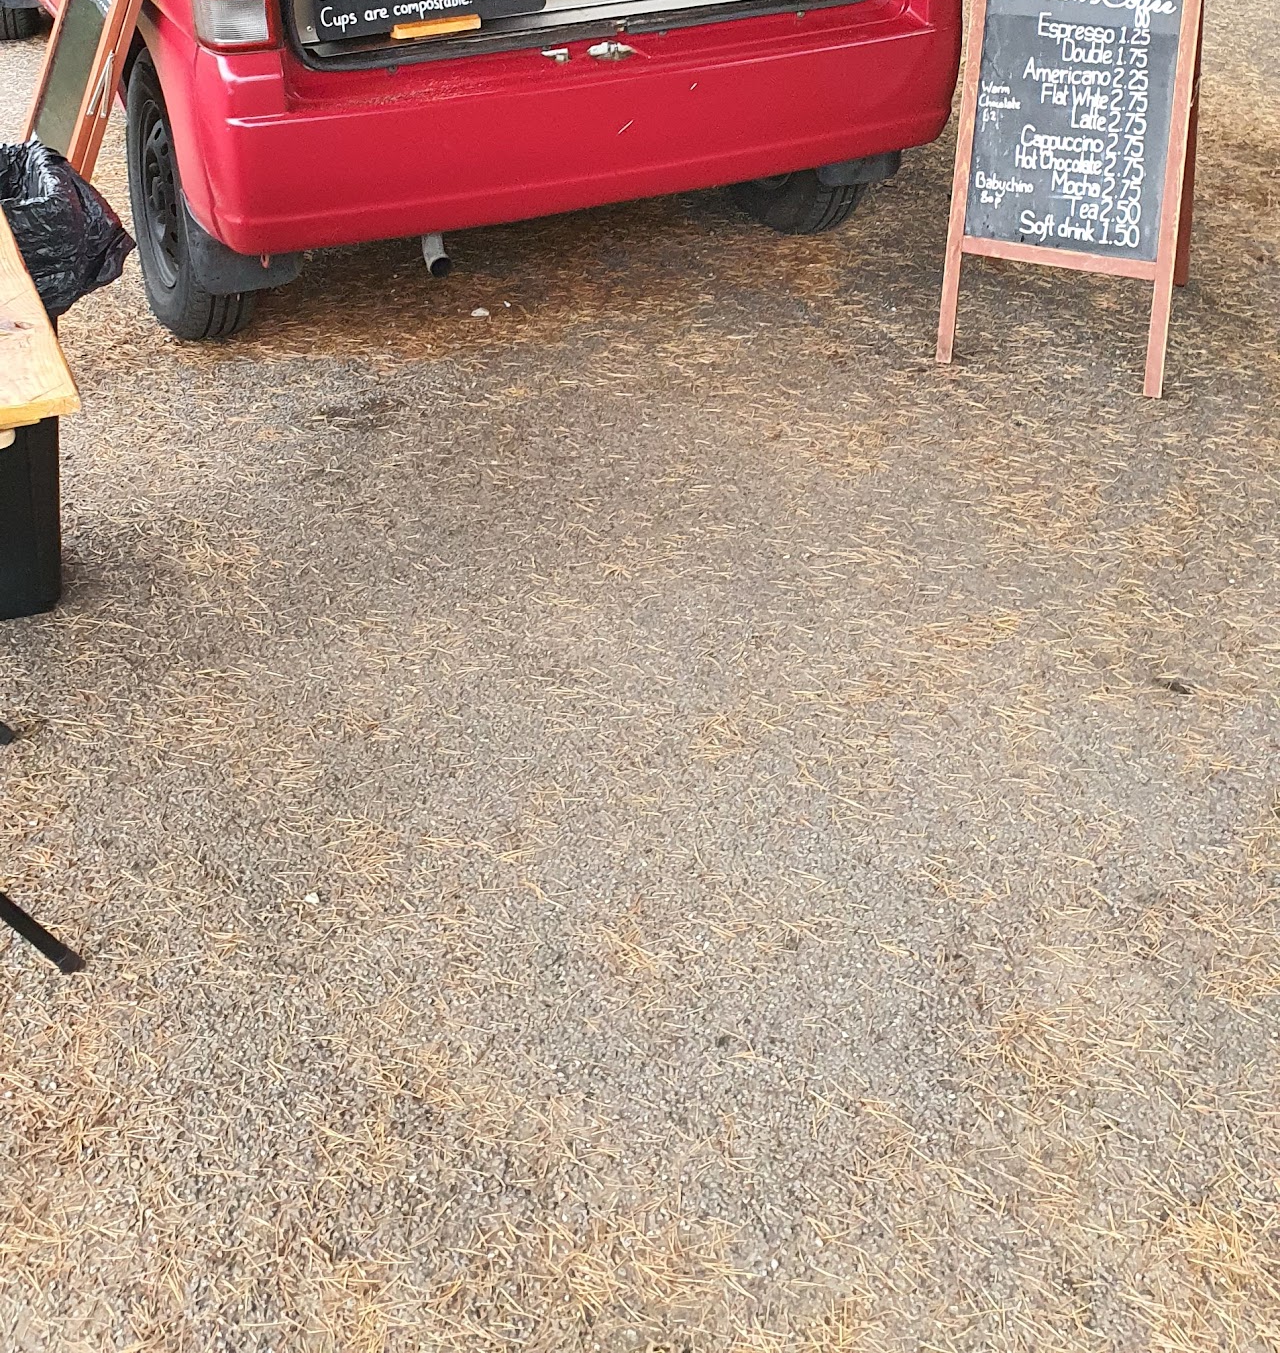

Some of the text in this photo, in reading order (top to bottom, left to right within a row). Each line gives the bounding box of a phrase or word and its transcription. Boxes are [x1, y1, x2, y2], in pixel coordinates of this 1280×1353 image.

[320, 6, 358, 33] Cups
[364, 7, 390, 21] are
[1037, 12, 1151, 46] Espresso 1.25
[1061, 38, 1149, 68] Double 1.75
[1022, 56, 1149, 91] Americano 2.25
[1040, 82, 1149, 113] Flat White 2.75
[1070, 105, 1148, 135] Latte 2.75
[1020, 124, 1145, 158] Cappuccino 2.75
[1015, 144, 1145, 182] Hot Chocolate 2.75
[975, 170, 1034, 198] Babychino
[1051, 170, 1142, 203] Mocha 2.75
[1062, 195, 1142, 226] Tea 2.50
[1019, 209, 1141, 248] Soft drink 1.50
